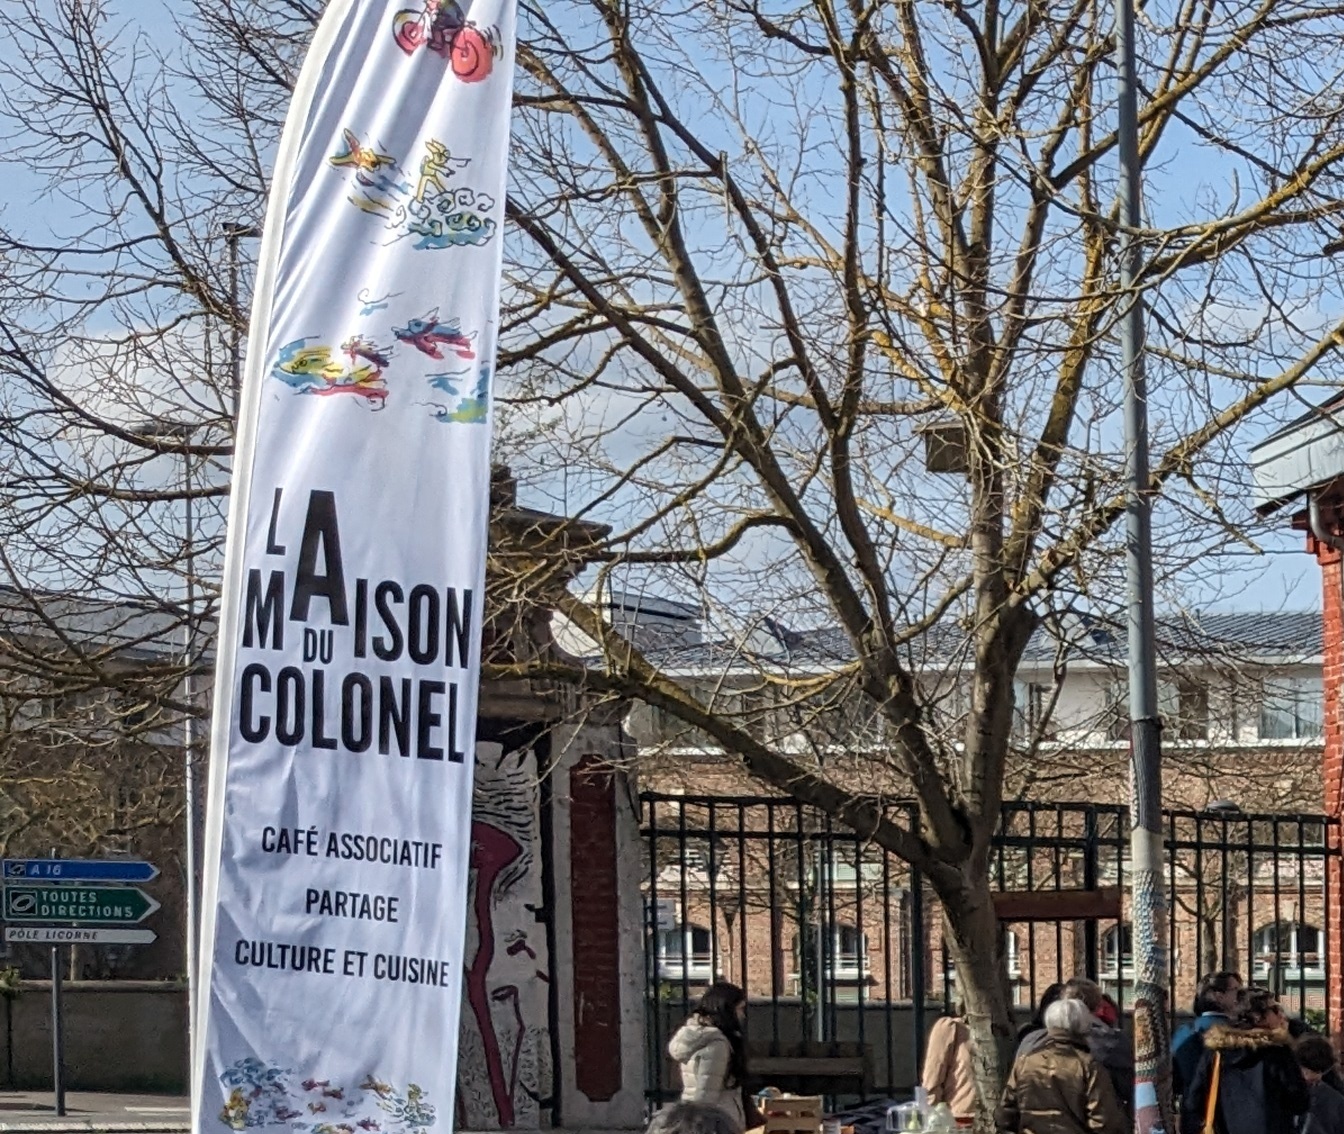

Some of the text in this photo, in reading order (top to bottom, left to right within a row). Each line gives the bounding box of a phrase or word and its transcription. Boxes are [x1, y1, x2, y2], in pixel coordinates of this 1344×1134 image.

[303, 628, 334, 664] DU
[239, 663, 465, 763] COLONEL
[262, 826, 443, 869] CAFÉ ASSOCIATIF
[31, 865, 61, 876] A 16
[41, 905, 133, 918] DIRECTIONS
[42, 891, 97, 903] TOUTES
[306, 888, 399, 923] PARTAGE
[9, 928, 98, 940] PÔLE LICORNE
[235, 939, 449, 987] CULTURE ET CUISINE
